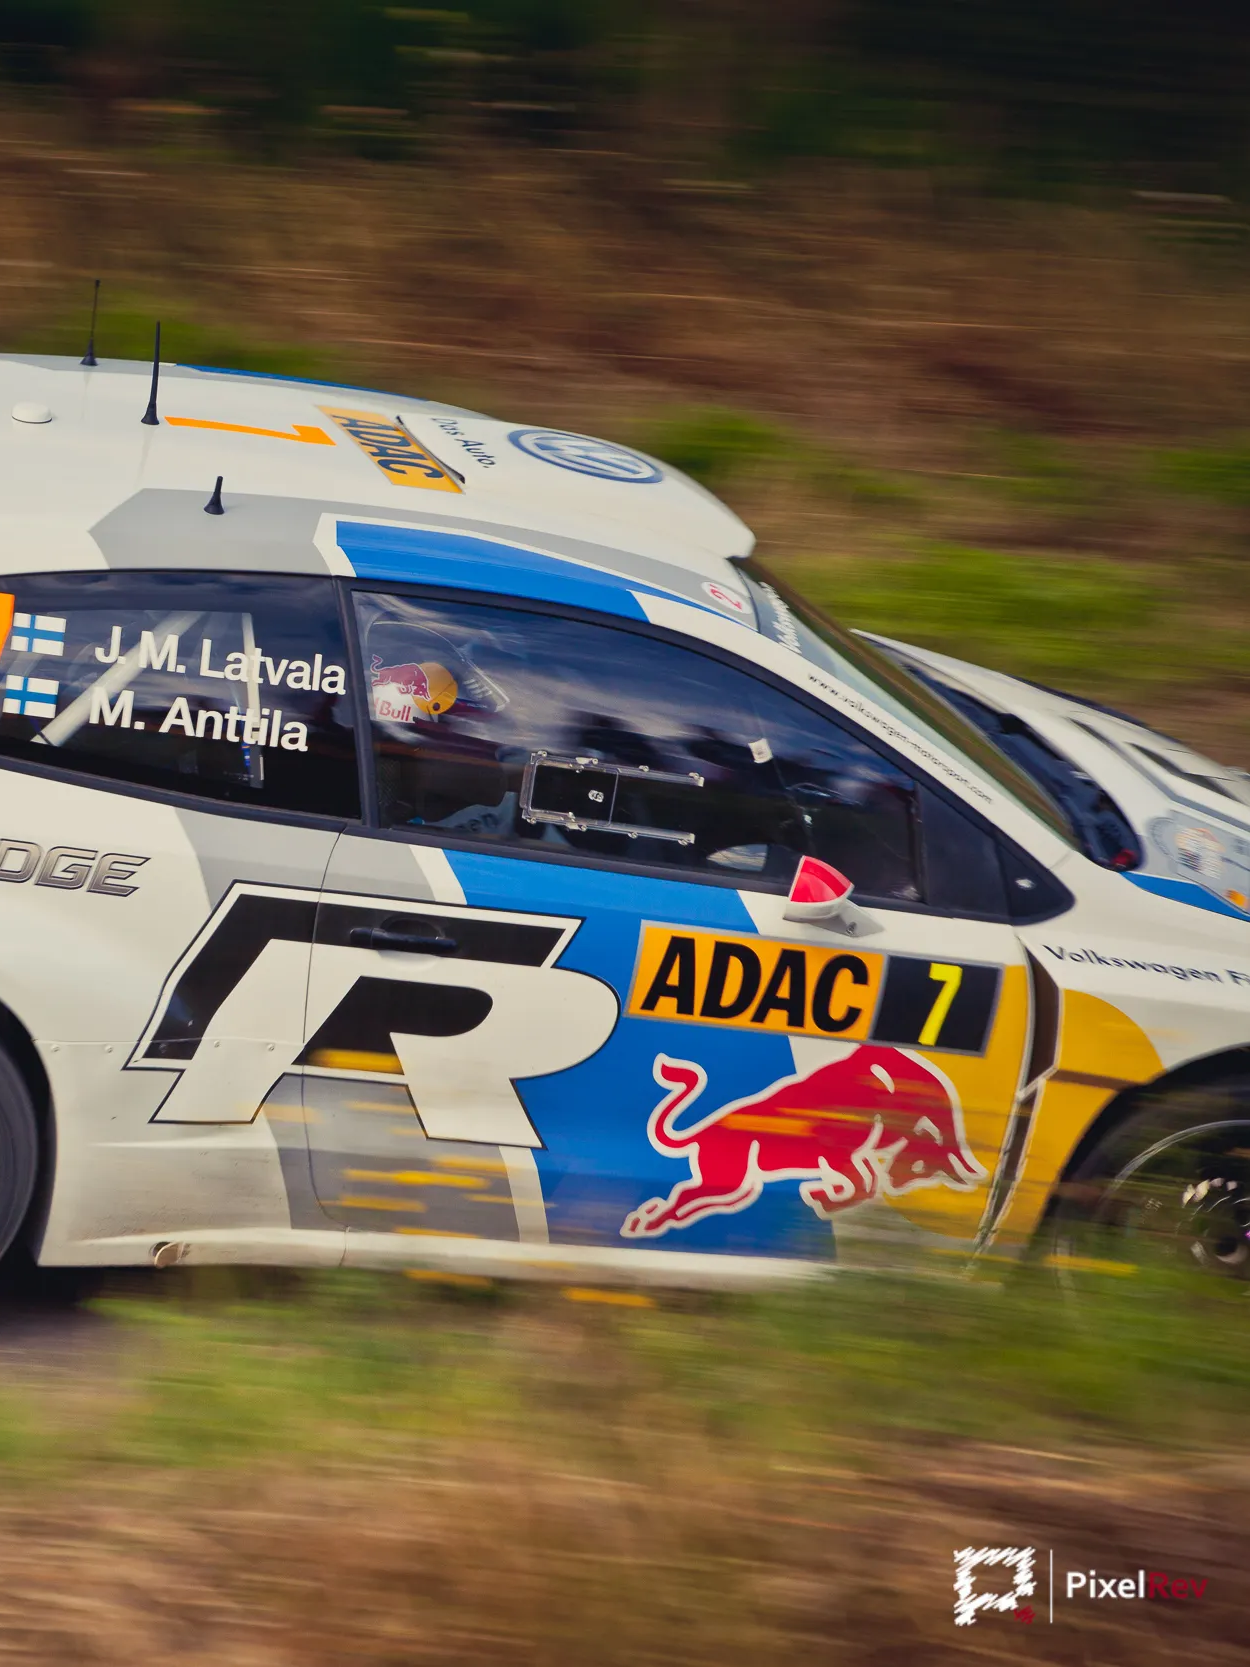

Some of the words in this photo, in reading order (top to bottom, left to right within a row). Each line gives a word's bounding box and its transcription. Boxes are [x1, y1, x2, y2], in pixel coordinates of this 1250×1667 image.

[331, 414, 445, 480] ADAC
[94, 625, 126, 665] J.
[137, 630, 186, 674] M.
[199, 638, 346, 695] Latvala
[89, 685, 146, 731] M.
[158, 696, 309, 752] Anttila
[639, 935, 869, 1033] ADAC
[918, 963, 963, 1048] 7
[1041, 944, 1224, 982] Volkswagen
[122, 879, 621, 1150] R
